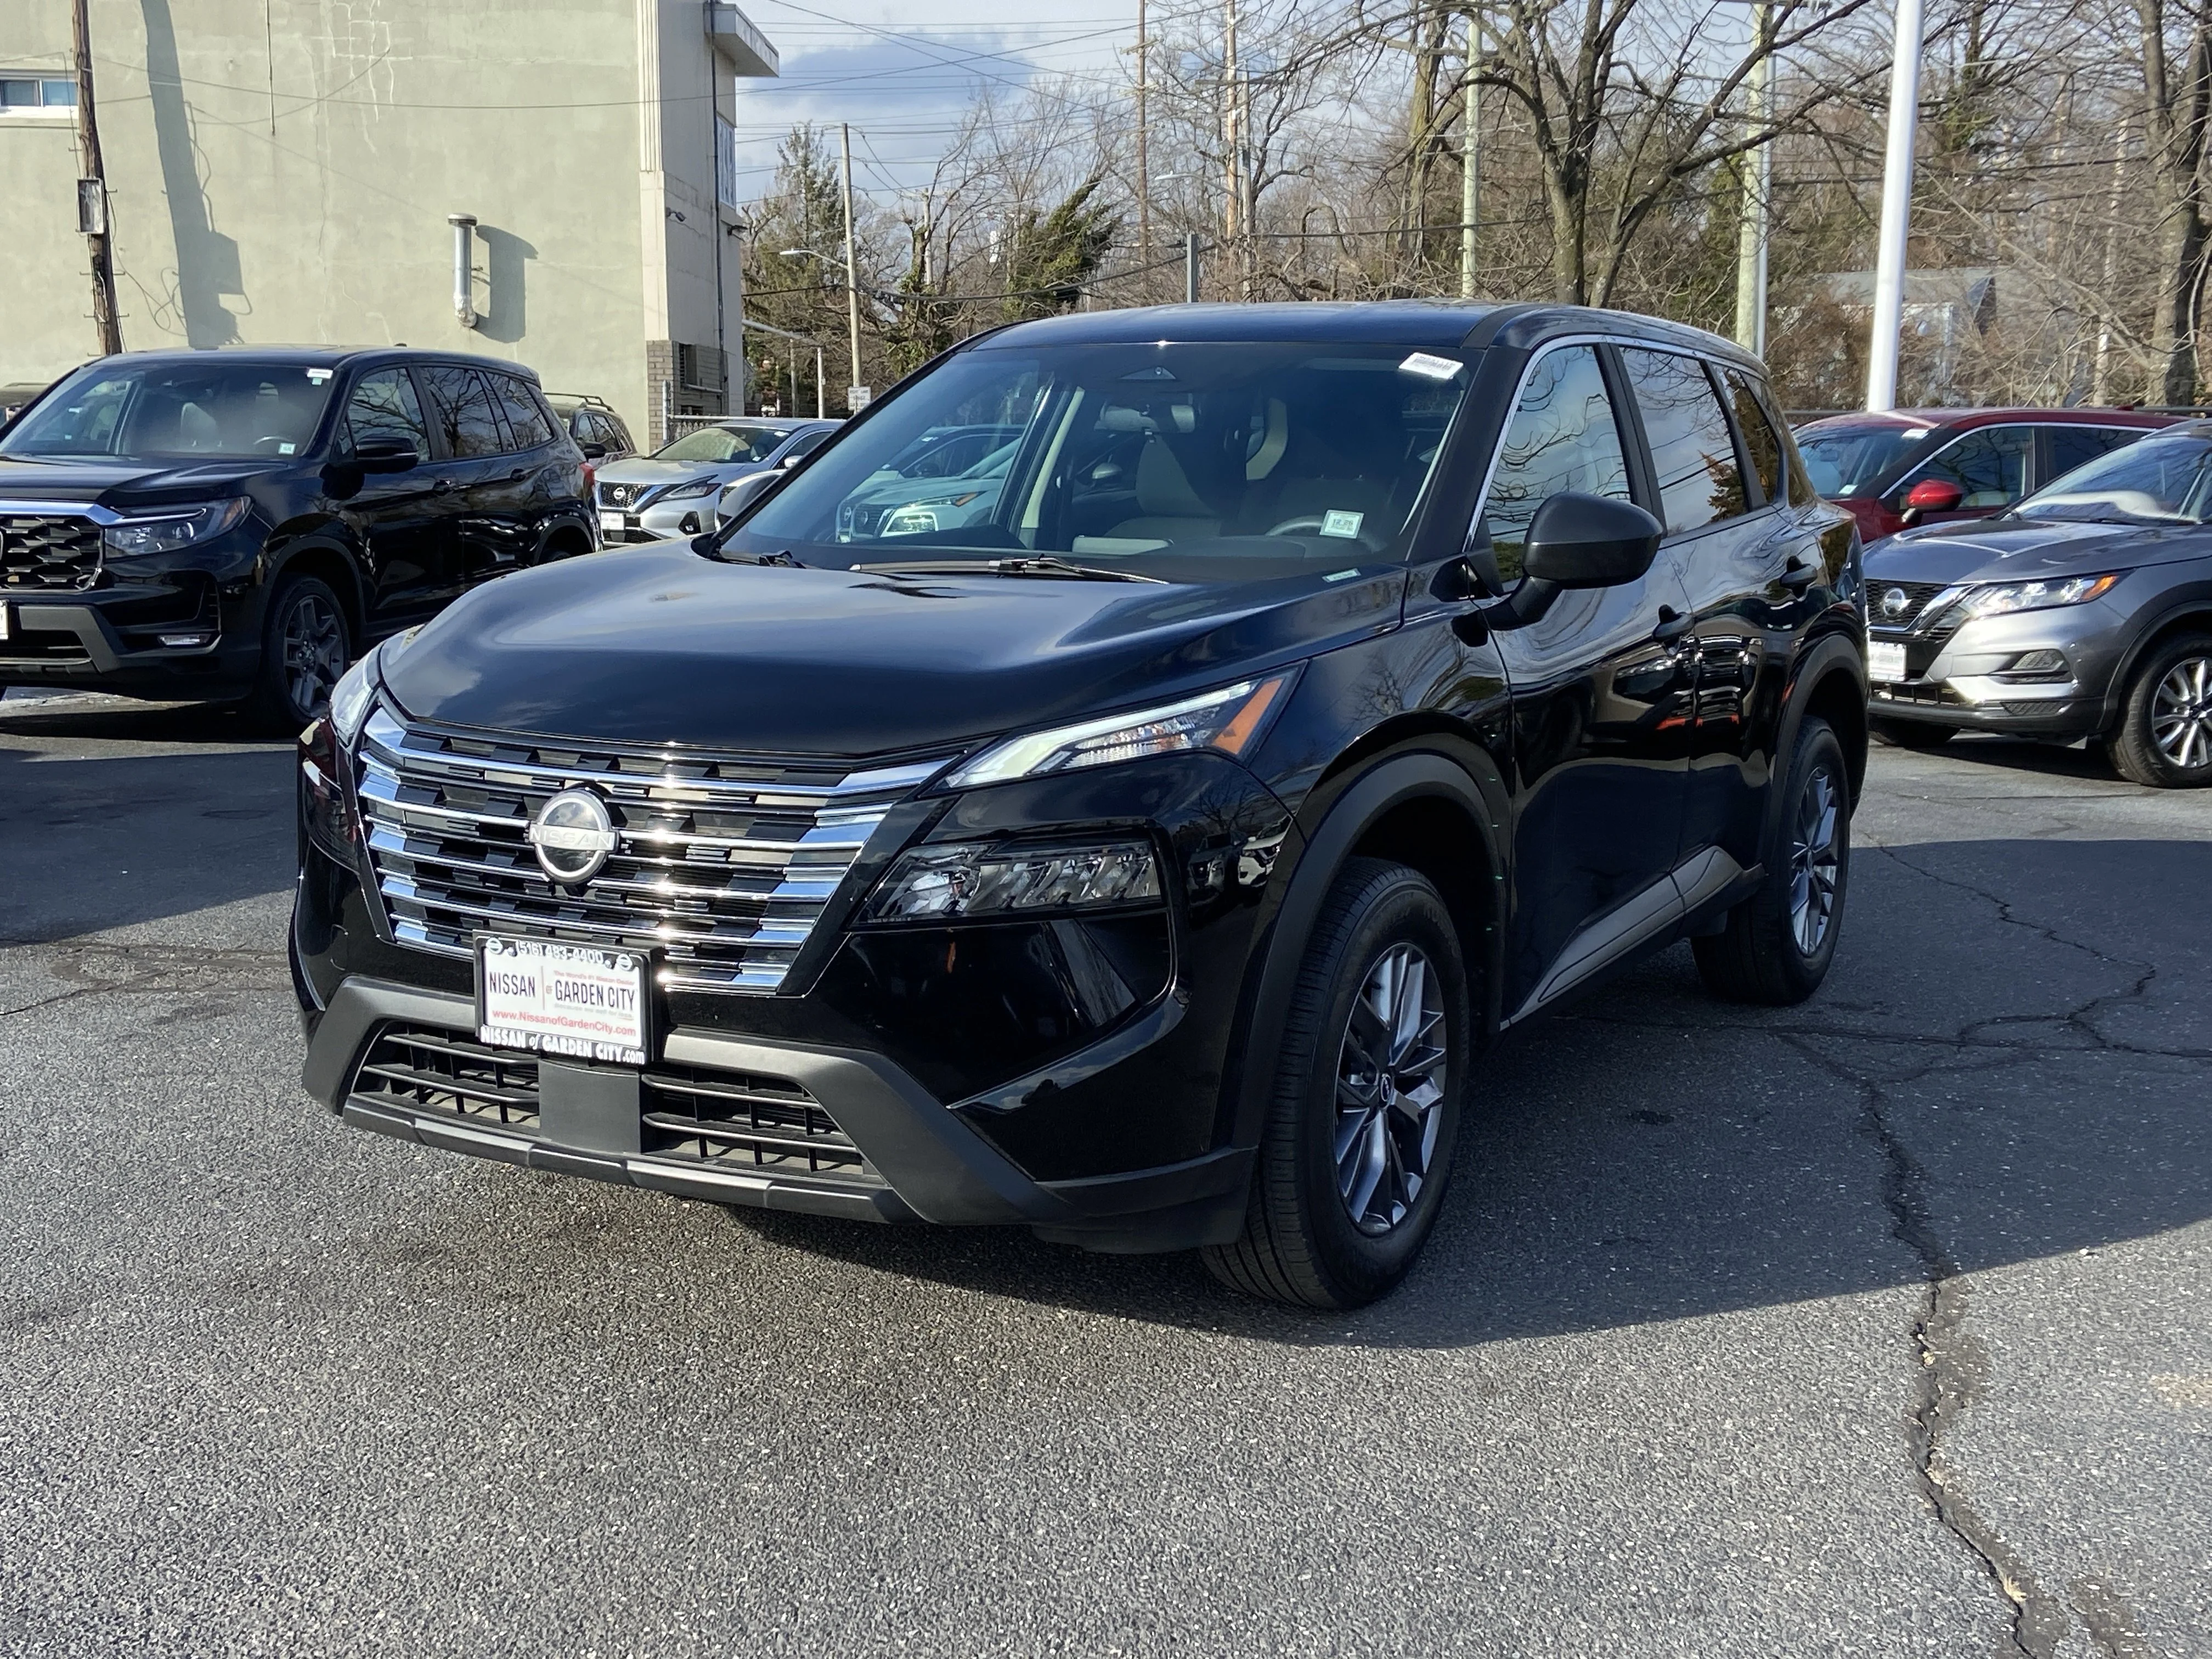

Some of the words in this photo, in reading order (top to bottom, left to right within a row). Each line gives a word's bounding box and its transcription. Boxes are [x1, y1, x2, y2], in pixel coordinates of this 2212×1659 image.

[530, 827, 612, 848] NISSAN
[516, 940, 543, 956] (516)
[489, 971, 535, 997] NISSAN
[555, 979, 605, 1007] GARDEN
[608, 986, 635, 1011] CITY
[492, 1010, 636, 1036] www.NissanofGardenCity.com
[481, 1025, 527, 1048] NISSAN
[528, 1034, 541, 1050] of
[542, 1035, 592, 1058] GARDEN
